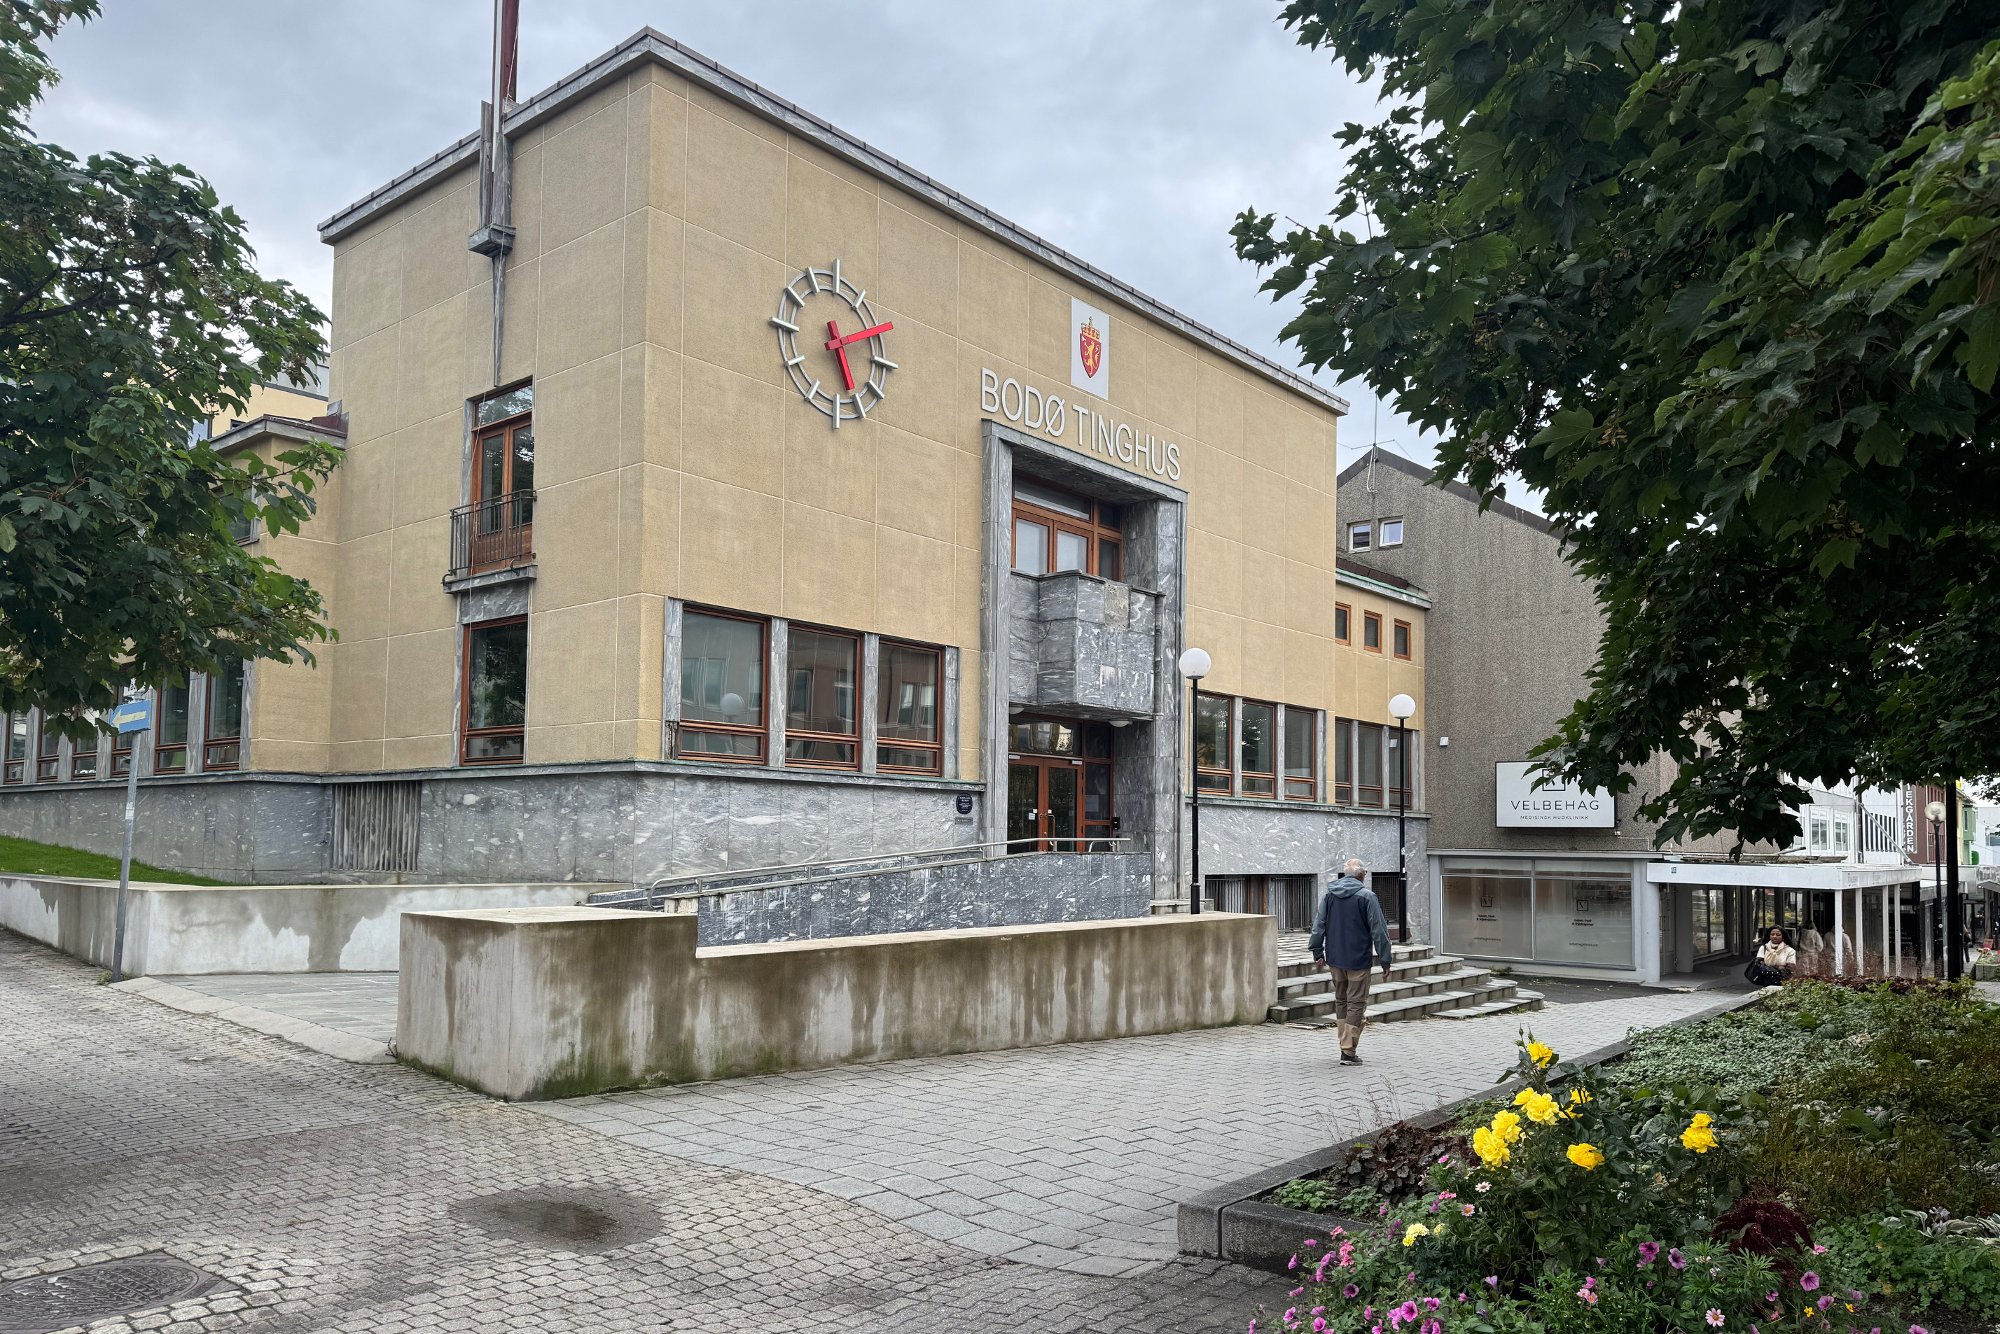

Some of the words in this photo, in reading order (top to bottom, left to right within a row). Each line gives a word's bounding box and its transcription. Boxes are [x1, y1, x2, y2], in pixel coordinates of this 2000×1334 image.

[981, 367, 1065, 437] BODØ
[1071, 404, 1181, 481] TINGHUS
[1510, 800, 1600, 811] VELBEHAG
